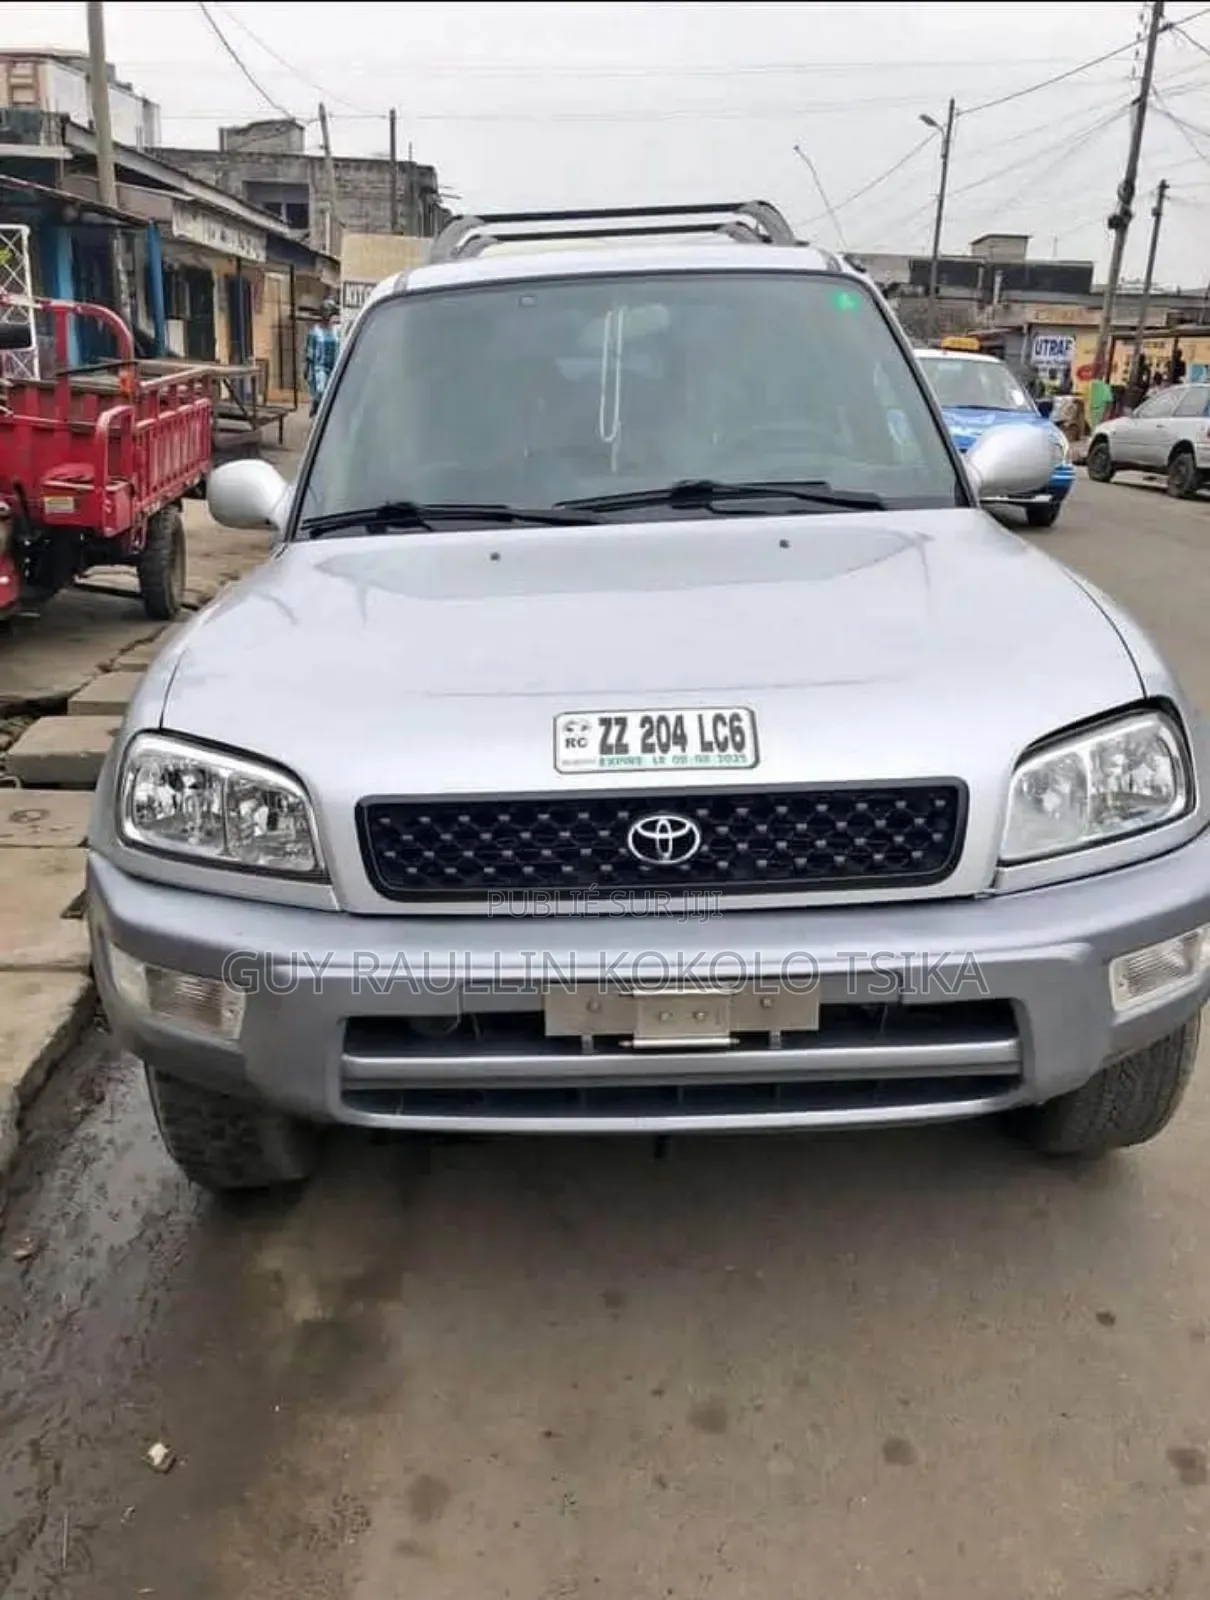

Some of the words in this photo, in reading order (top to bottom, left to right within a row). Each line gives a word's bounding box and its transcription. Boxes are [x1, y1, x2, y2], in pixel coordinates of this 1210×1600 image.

[564, 737, 589, 750] RC
[598, 715, 629, 756] ZZ
[640, 713, 688, 754] 204
[697, 711, 746, 754] LC6
